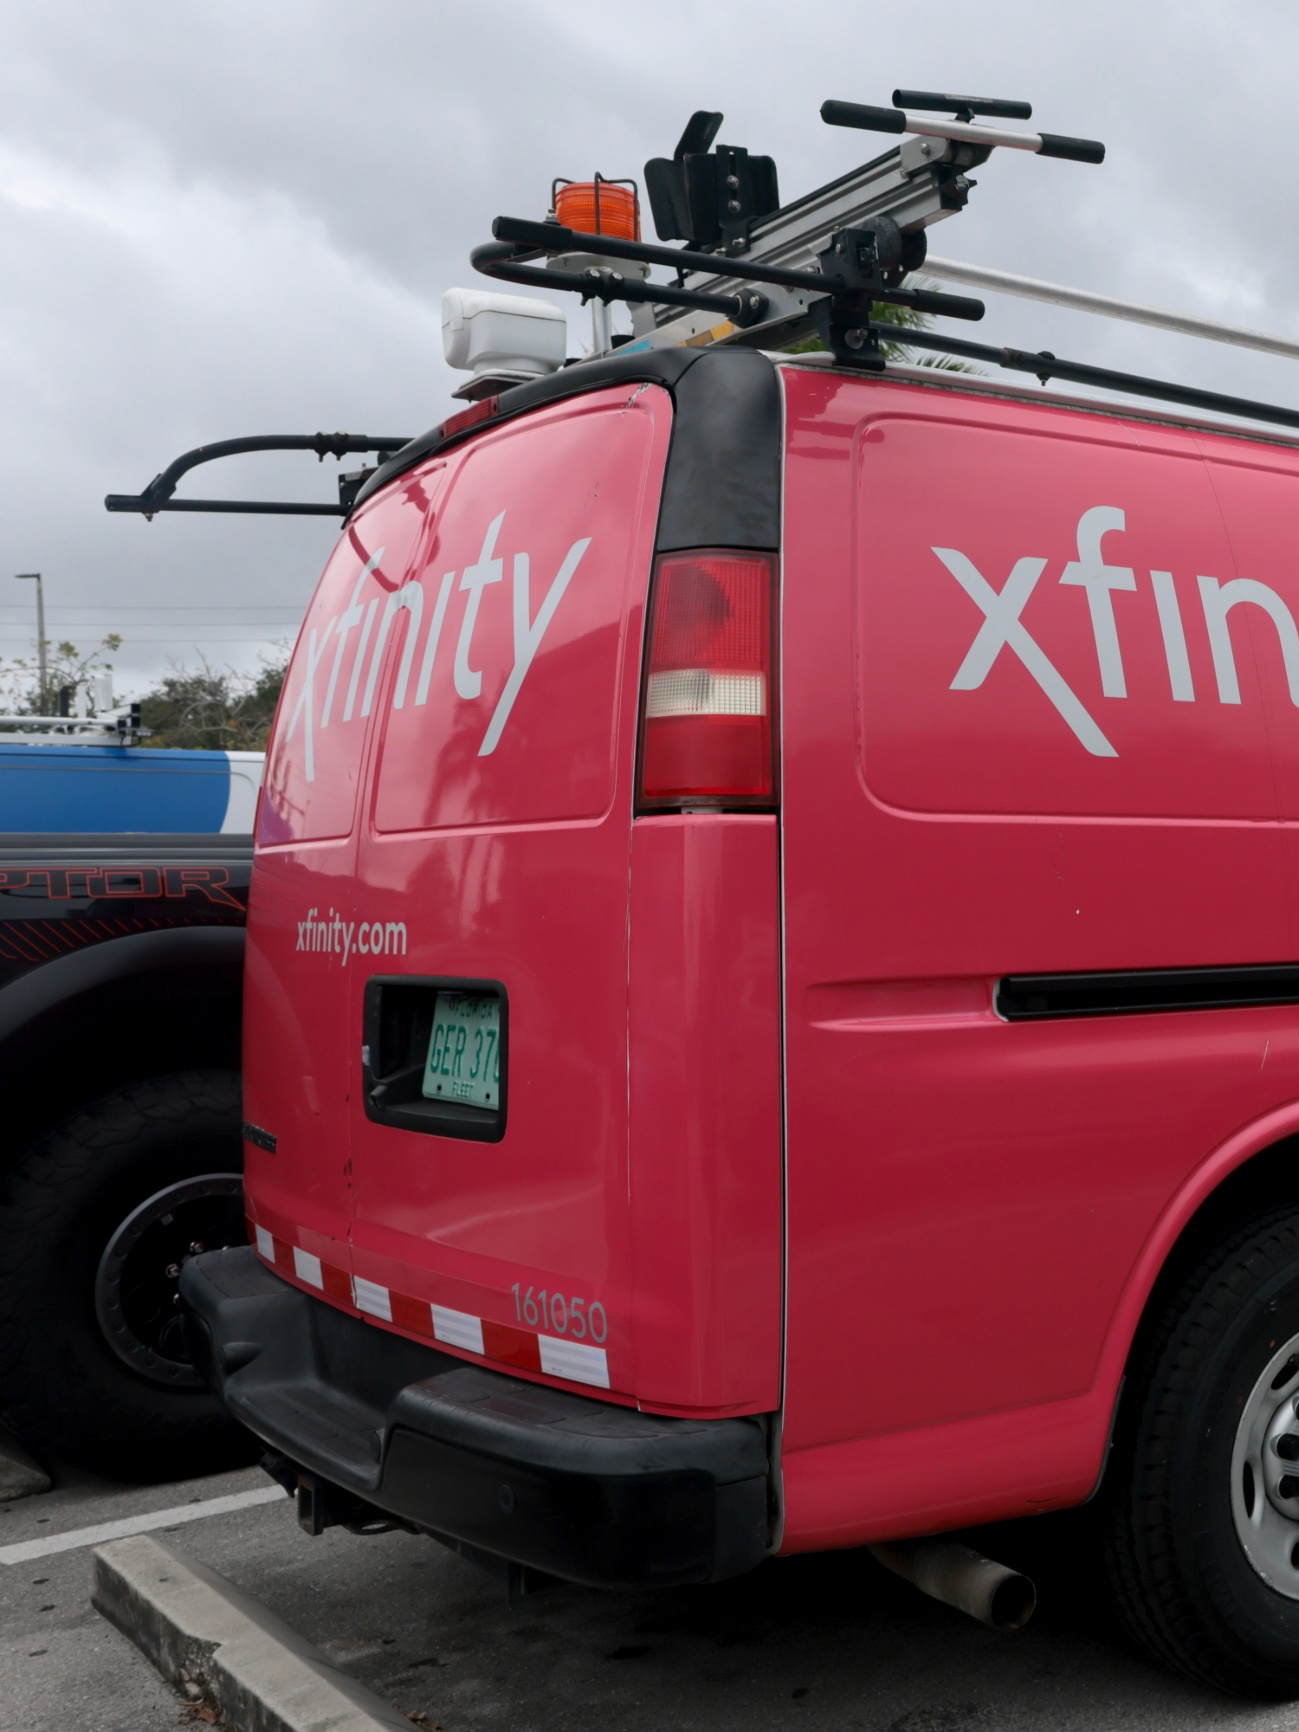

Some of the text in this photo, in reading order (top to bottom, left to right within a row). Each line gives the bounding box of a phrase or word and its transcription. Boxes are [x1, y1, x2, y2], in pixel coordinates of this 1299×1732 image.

[286, 508, 592, 782] xfinity
[296, 907, 407, 967] xfinity.com
[455, 1001, 492, 1019] FLORIDA
[430, 1024, 466, 1077] GER
[451, 1081, 475, 1099] FLEET
[512, 1282, 607, 1343] 161050
